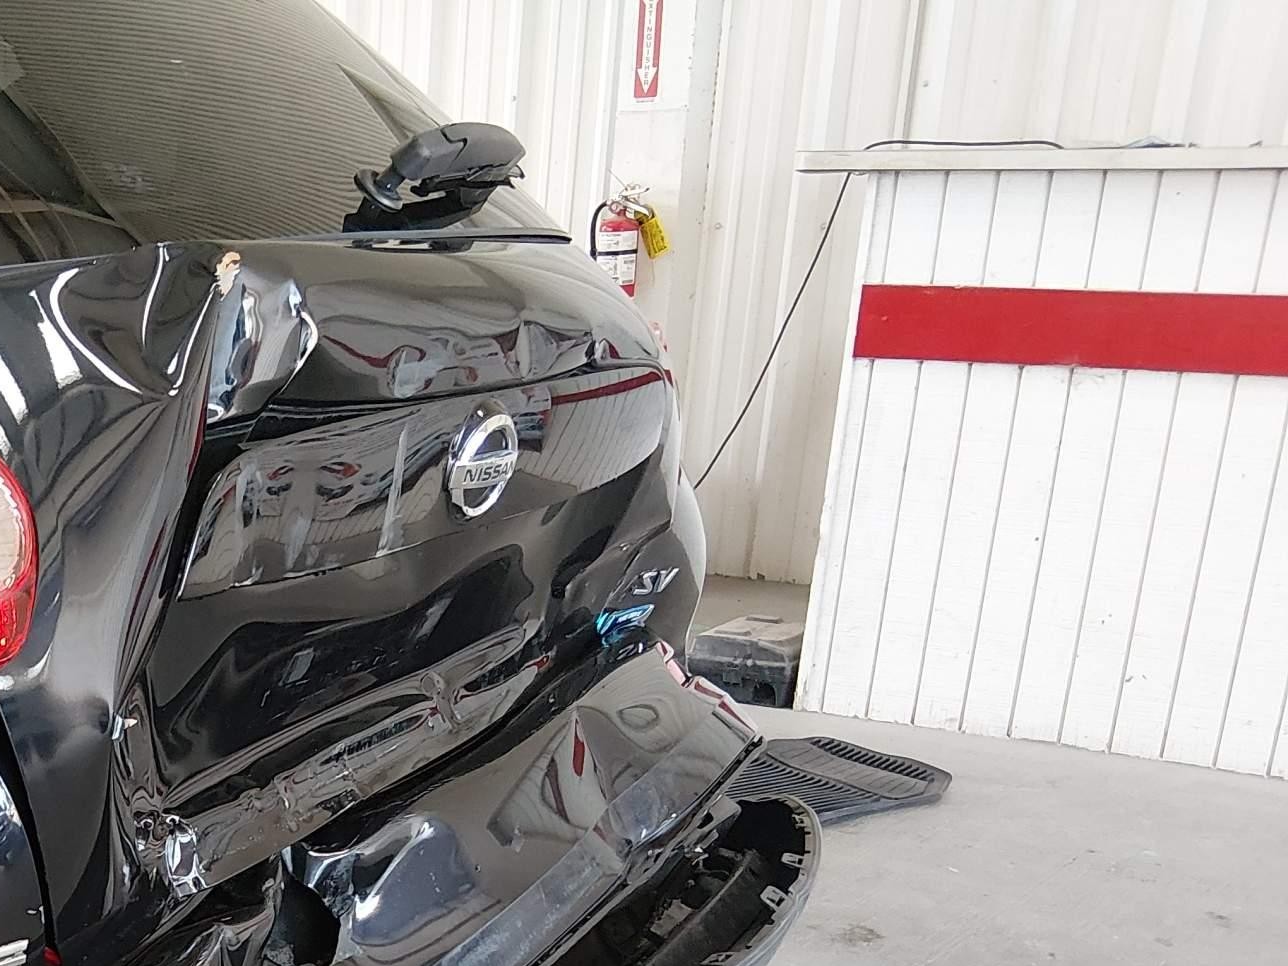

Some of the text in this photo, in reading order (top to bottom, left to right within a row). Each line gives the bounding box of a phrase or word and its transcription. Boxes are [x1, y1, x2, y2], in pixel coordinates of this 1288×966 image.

[643, 0, 654, 86] XTINGUISHER
[462, 461, 514, 484] NISSAN
[632, 567, 680, 596] SV
